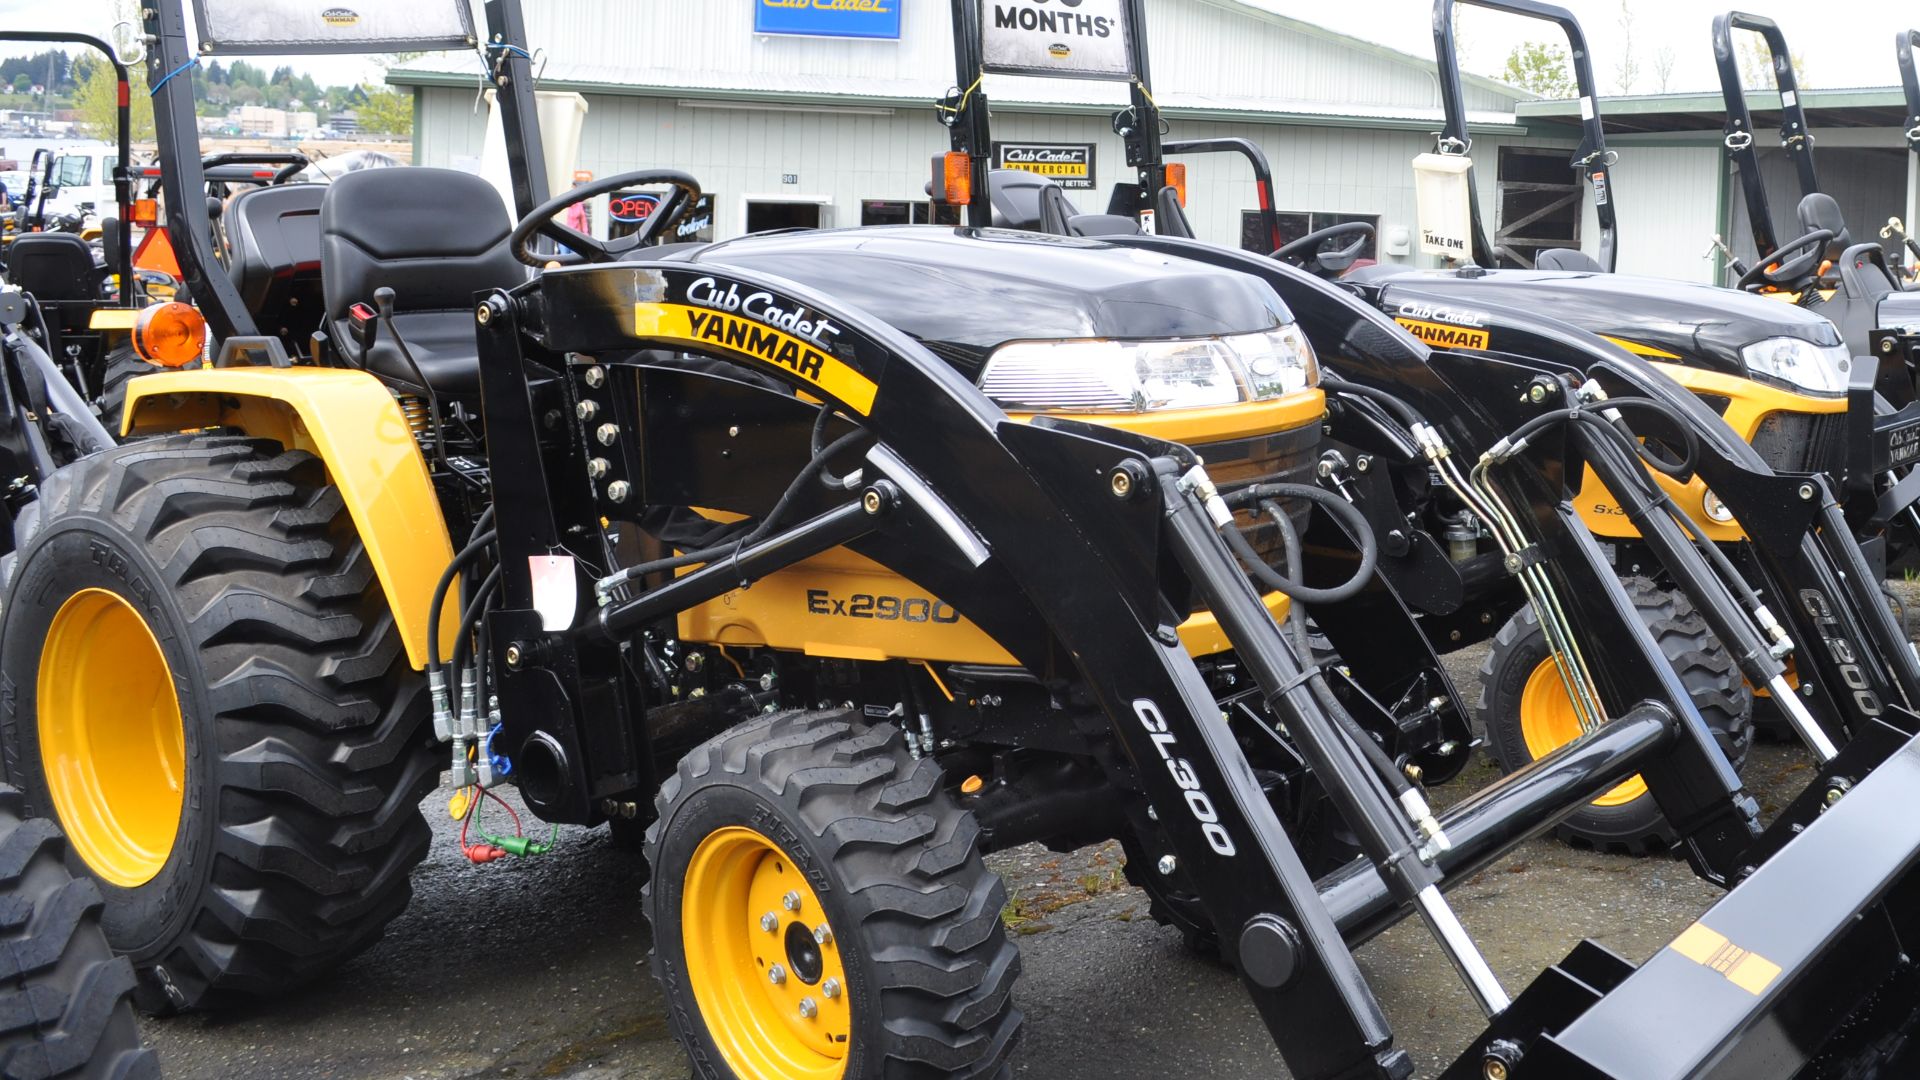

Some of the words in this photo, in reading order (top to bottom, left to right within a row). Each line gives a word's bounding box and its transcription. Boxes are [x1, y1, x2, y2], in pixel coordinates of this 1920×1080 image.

[1007, 149, 1035, 162] Cub
[1036, 150, 1083, 162] Cadet
[609, 200, 660, 218] OPEN
[1425, 234, 1445, 246] TAKE
[1447, 238, 1463, 250] ONE
[686, 277, 740, 312] Cub
[741, 292, 841, 352] Cadet
[1400, 301, 1431, 319] Cub
[1432, 306, 1490, 328] Cadet
[687, 309, 825, 382] YANMAR
[1400, 323, 1483, 348] YANMAR
[807, 589, 960, 624] Ex2900
[1800, 588, 1884, 716] CL200
[1132, 698, 1236, 857] CL300
[751, 803, 830, 892] TITAN
